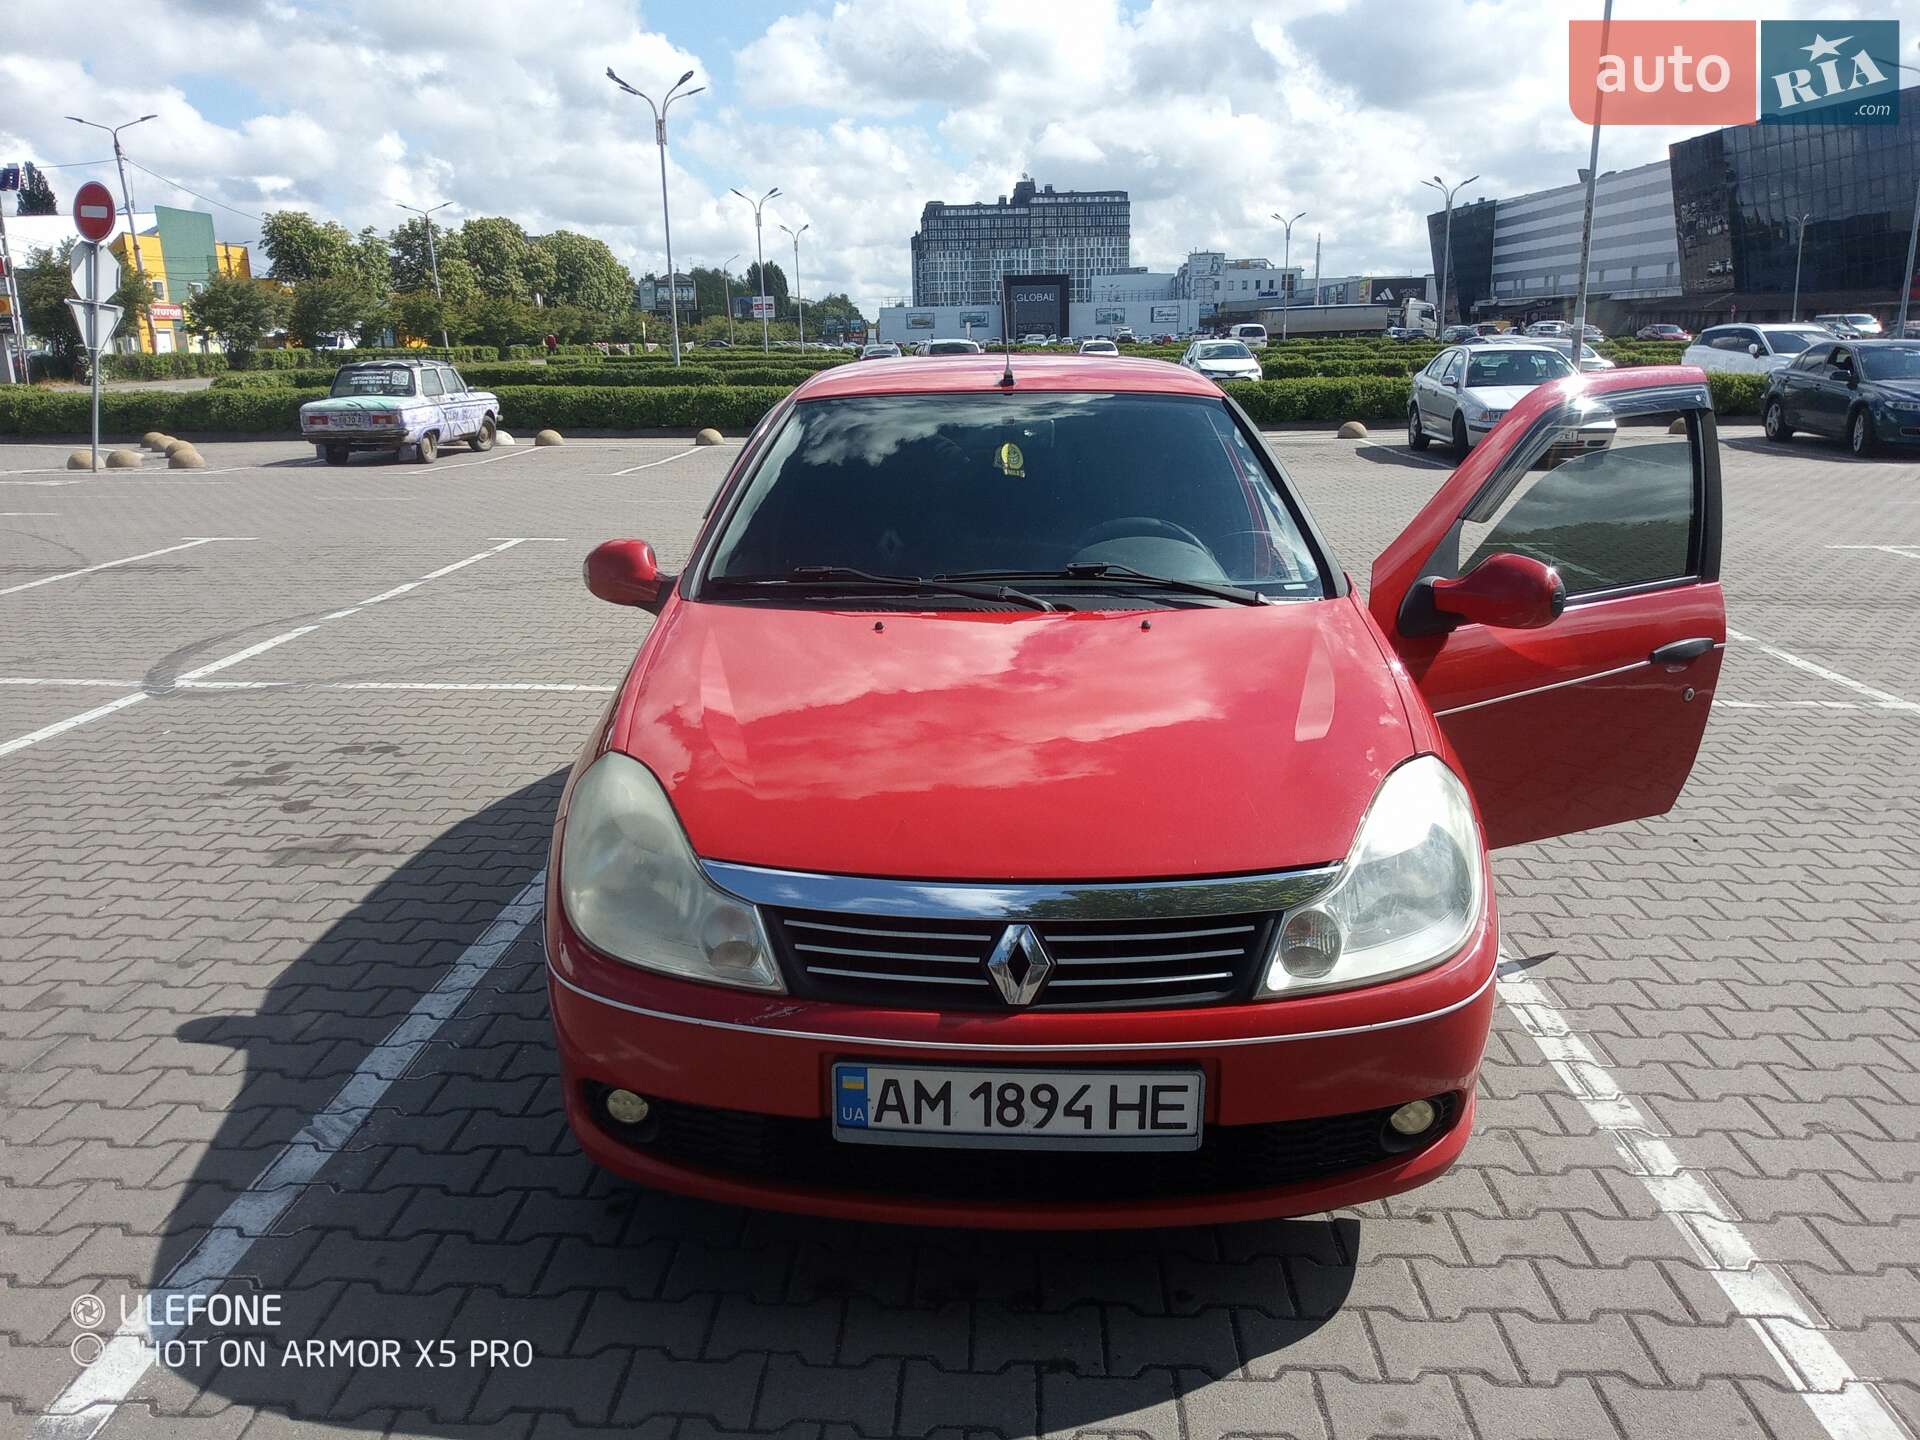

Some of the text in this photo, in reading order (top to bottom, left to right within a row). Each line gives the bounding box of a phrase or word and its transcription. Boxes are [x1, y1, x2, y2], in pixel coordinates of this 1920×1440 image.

[1016, 293, 1055, 302] GLOBAL
[873, 1078, 1189, 1130] AM 1894 HE
[843, 1106, 865, 1121] UA
